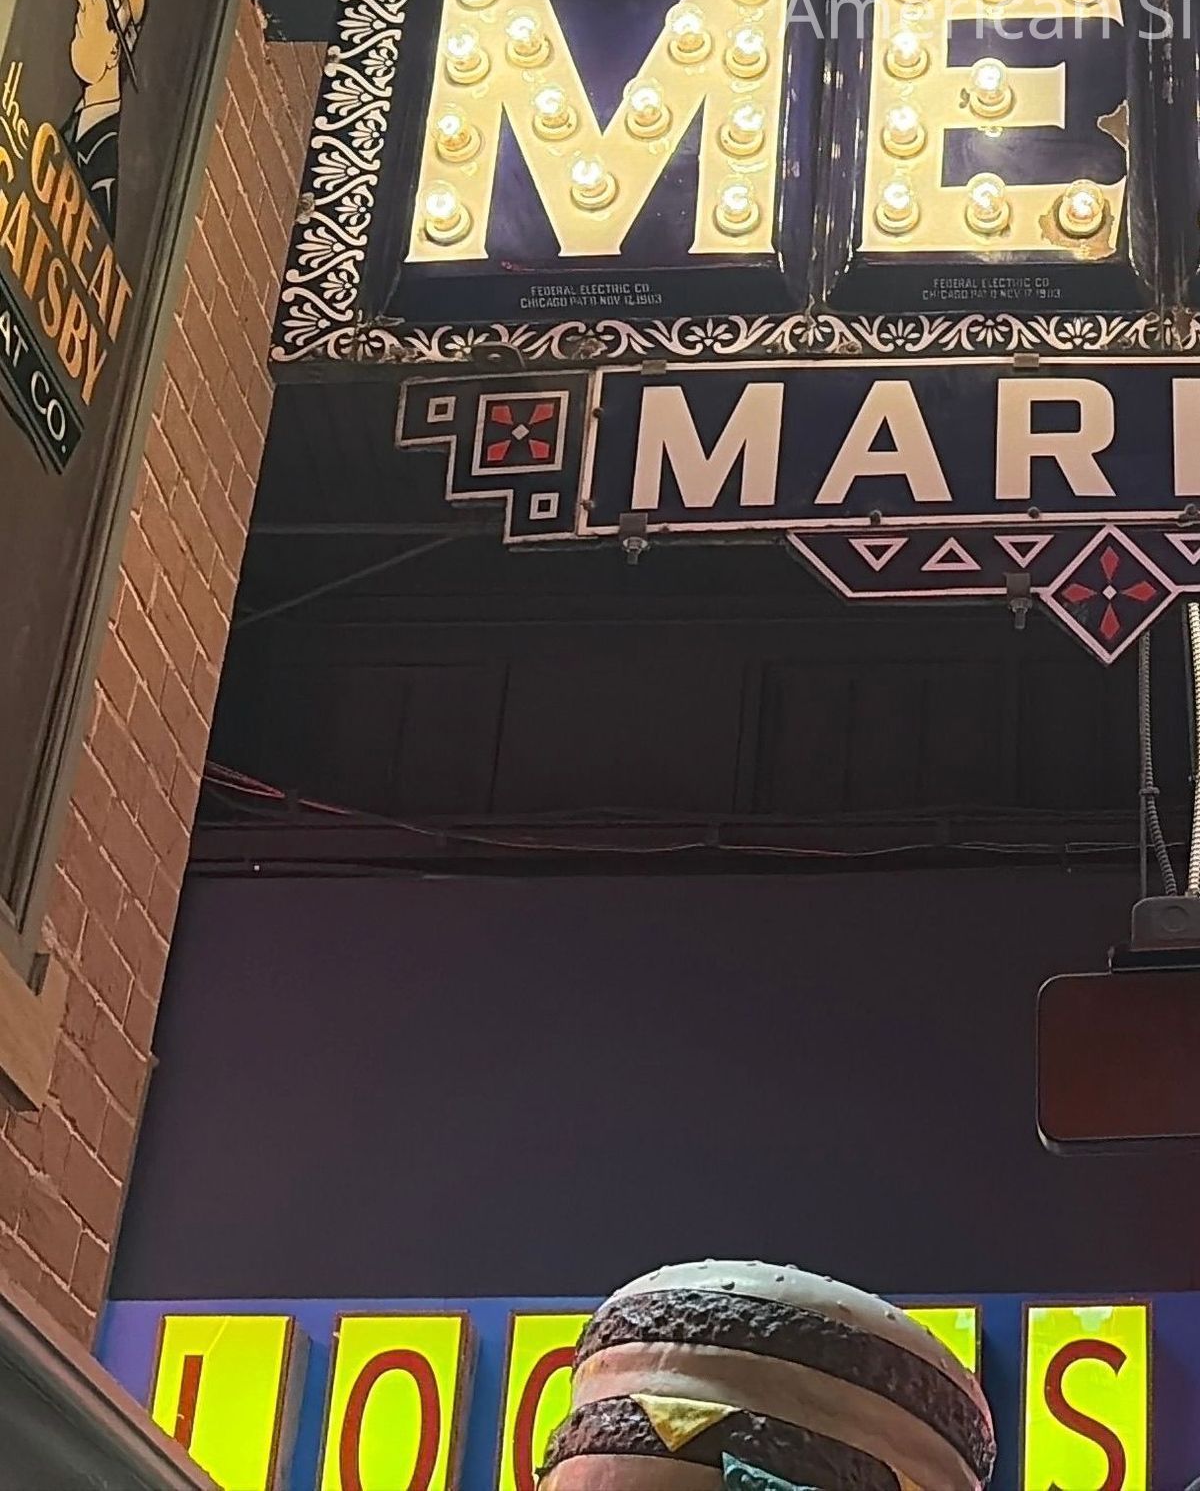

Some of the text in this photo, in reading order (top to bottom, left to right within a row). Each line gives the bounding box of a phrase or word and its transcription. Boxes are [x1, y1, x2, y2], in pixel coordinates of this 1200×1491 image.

[31, 121, 134, 344] GREAT
[933, 277, 978, 289] FEDERAL
[530, 285, 576, 297] FEDERAL
[580, 284, 631, 296] ELECTRIC
[922, 289, 968, 301] CHICAGO
[519, 296, 568, 309] CHICAGO
[31, 370, 67, 454] CO.
